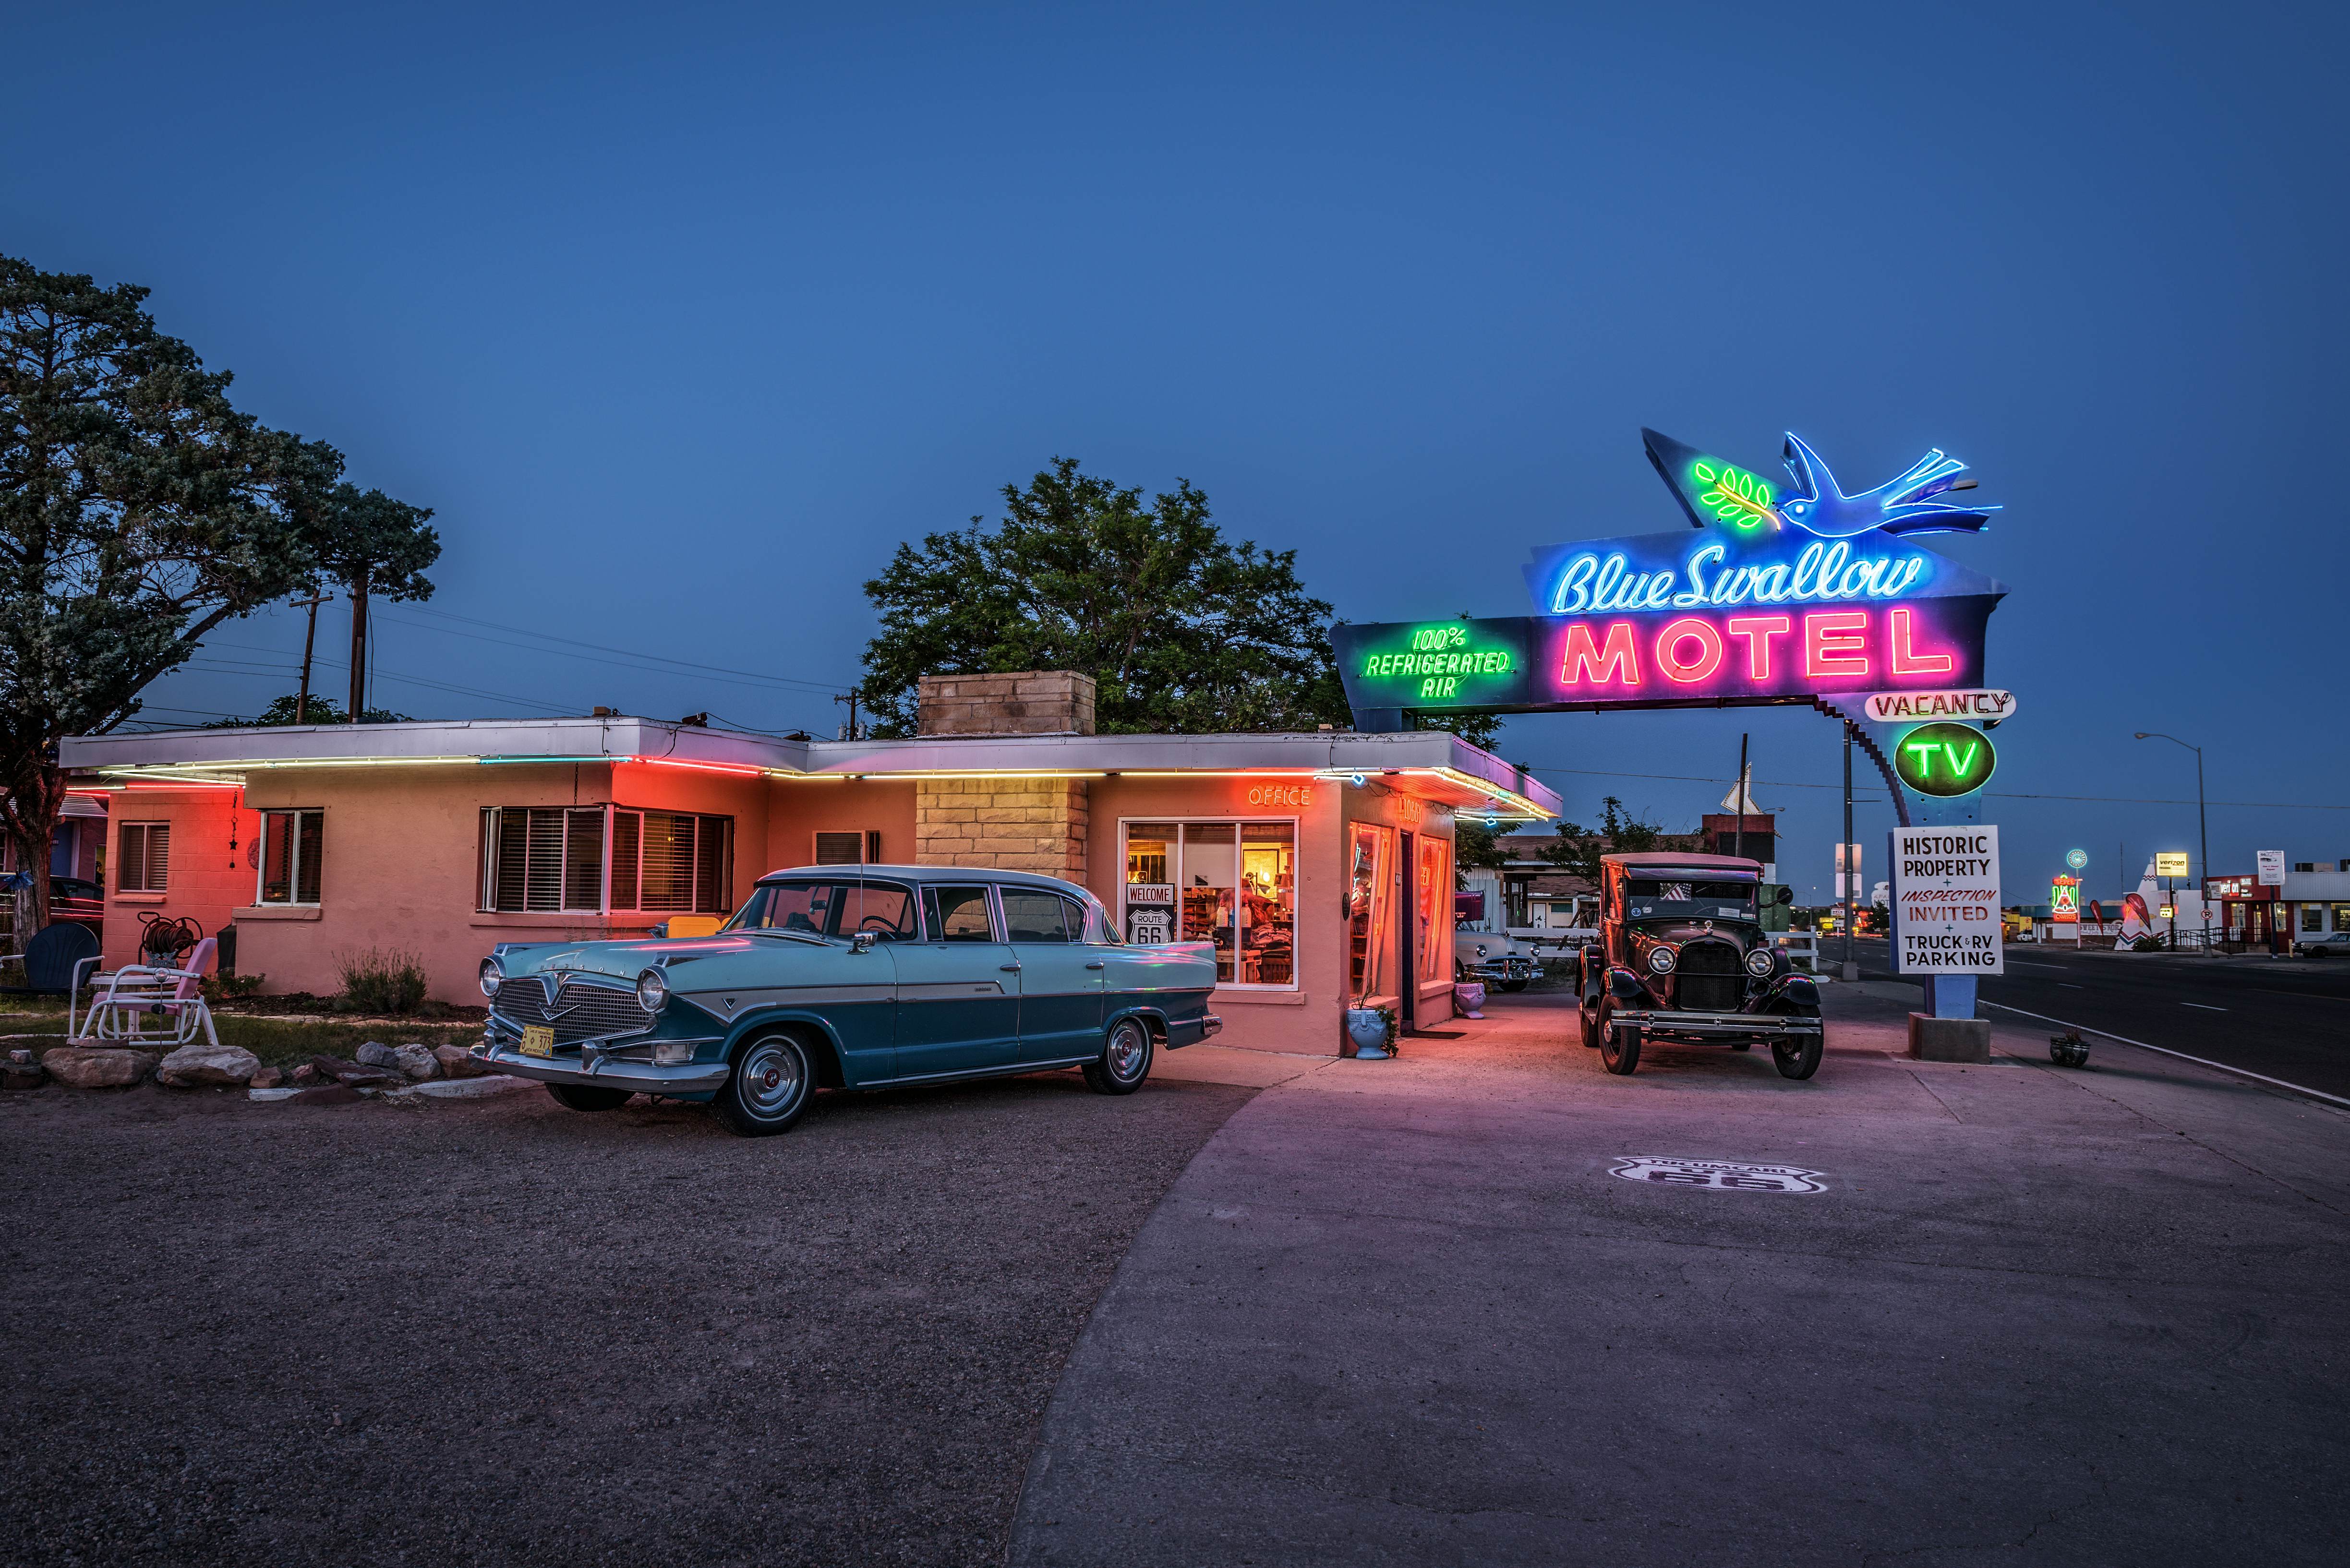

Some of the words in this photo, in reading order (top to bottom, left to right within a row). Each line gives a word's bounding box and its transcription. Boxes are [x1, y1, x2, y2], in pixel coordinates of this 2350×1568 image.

[1551, 553, 1676, 615] Blue
[1672, 540, 1922, 608] Swallow
[1412, 627, 1466, 651] 100%
[1561, 609, 1952, 684] MOTEL
[1366, 652, 1510, 676] REFRIGERATED
[1421, 677, 1455, 698] AIR
[1875, 693, 2013, 716] VACANCY
[1905, 742, 1978, 778] TV
[1249, 786, 1311, 806] OFFICE
[1400, 798, 1422, 824] LOBBY
[1903, 836, 1987, 855] HISTORIC
[1904, 859, 1991, 876] PROPERTY
[1130, 888, 1170, 902] WELCOME
[1901, 890, 1997, 902] INSPECTION
[1909, 907, 1988, 921] INVITED
[1138, 927, 1161, 944] 66
[1905, 935, 1963, 949] TRUCK
[1972, 935, 1993, 948] RV
[1906, 951, 1996, 966] PARKING
[539, 1035, 551, 1049] 373
[1648, 1159, 1786, 1173] TUCUMCARI
[1648, 1171, 1785, 1190] 66
